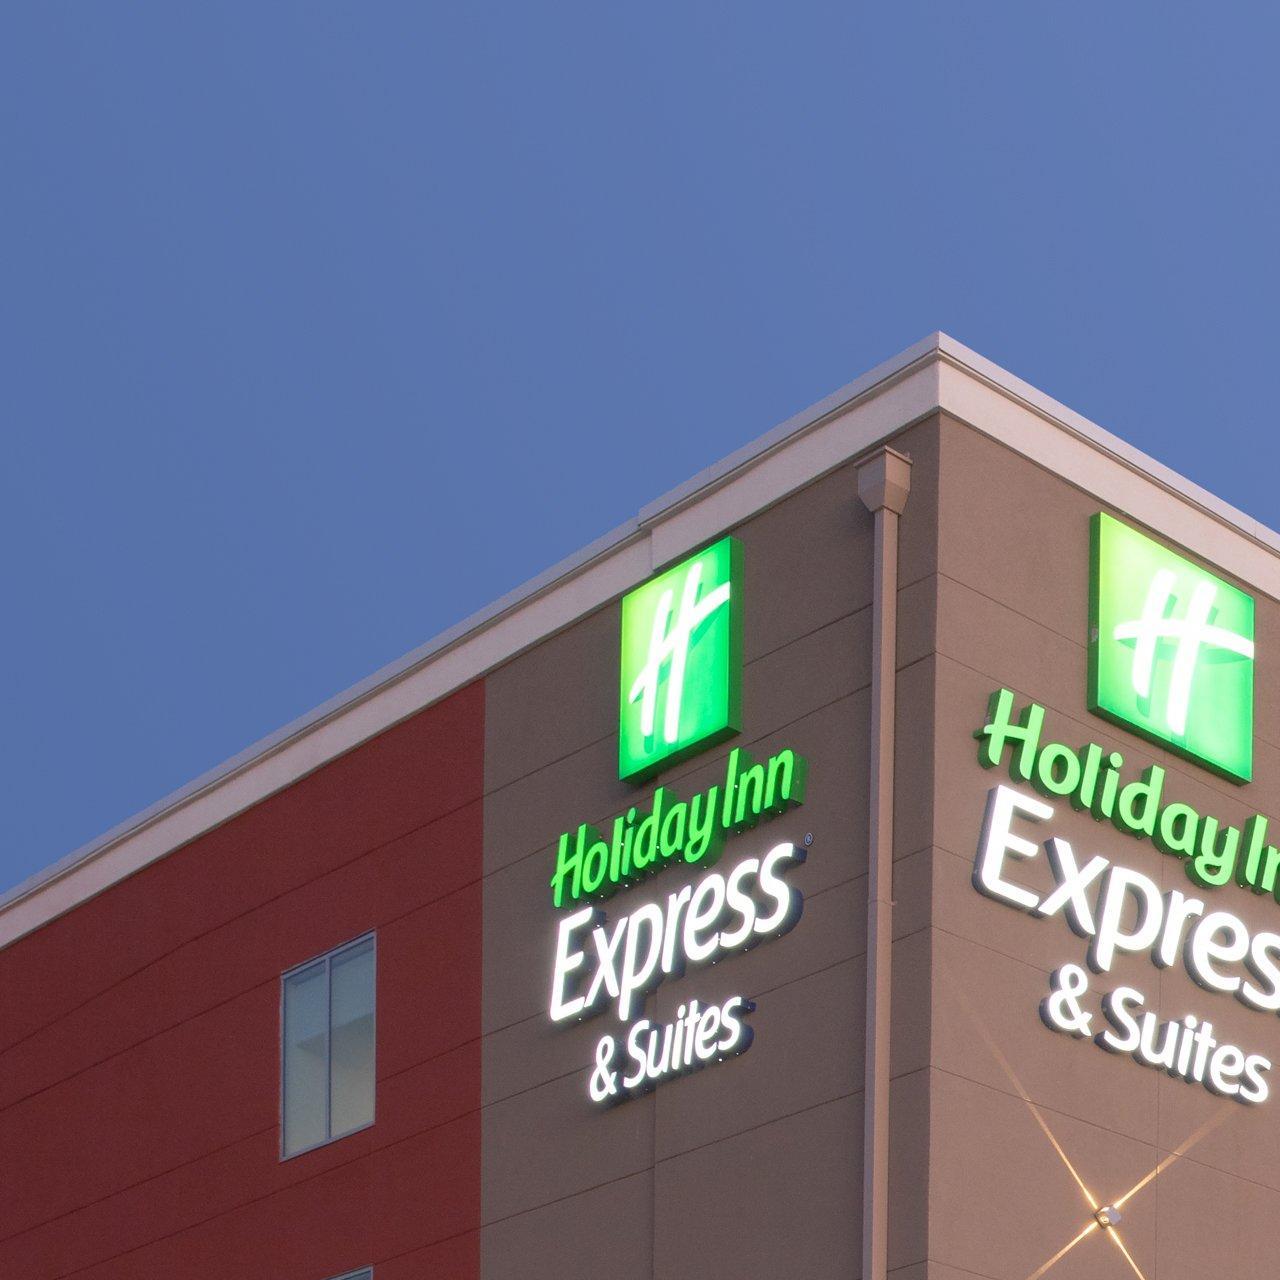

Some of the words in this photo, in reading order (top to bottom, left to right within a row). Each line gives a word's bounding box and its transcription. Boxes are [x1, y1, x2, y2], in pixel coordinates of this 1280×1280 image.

[550, 786, 719, 908] Holiday
[722, 747, 794, 828] Inn
[984, 688, 1240, 886] Holiday
[550, 842, 793, 1022] Express
[589, 1034, 617, 1102] &
[623, 995, 742, 1089] Suites
[1048, 963, 1093, 1038] &
[1103, 986, 1272, 1103] Suites
